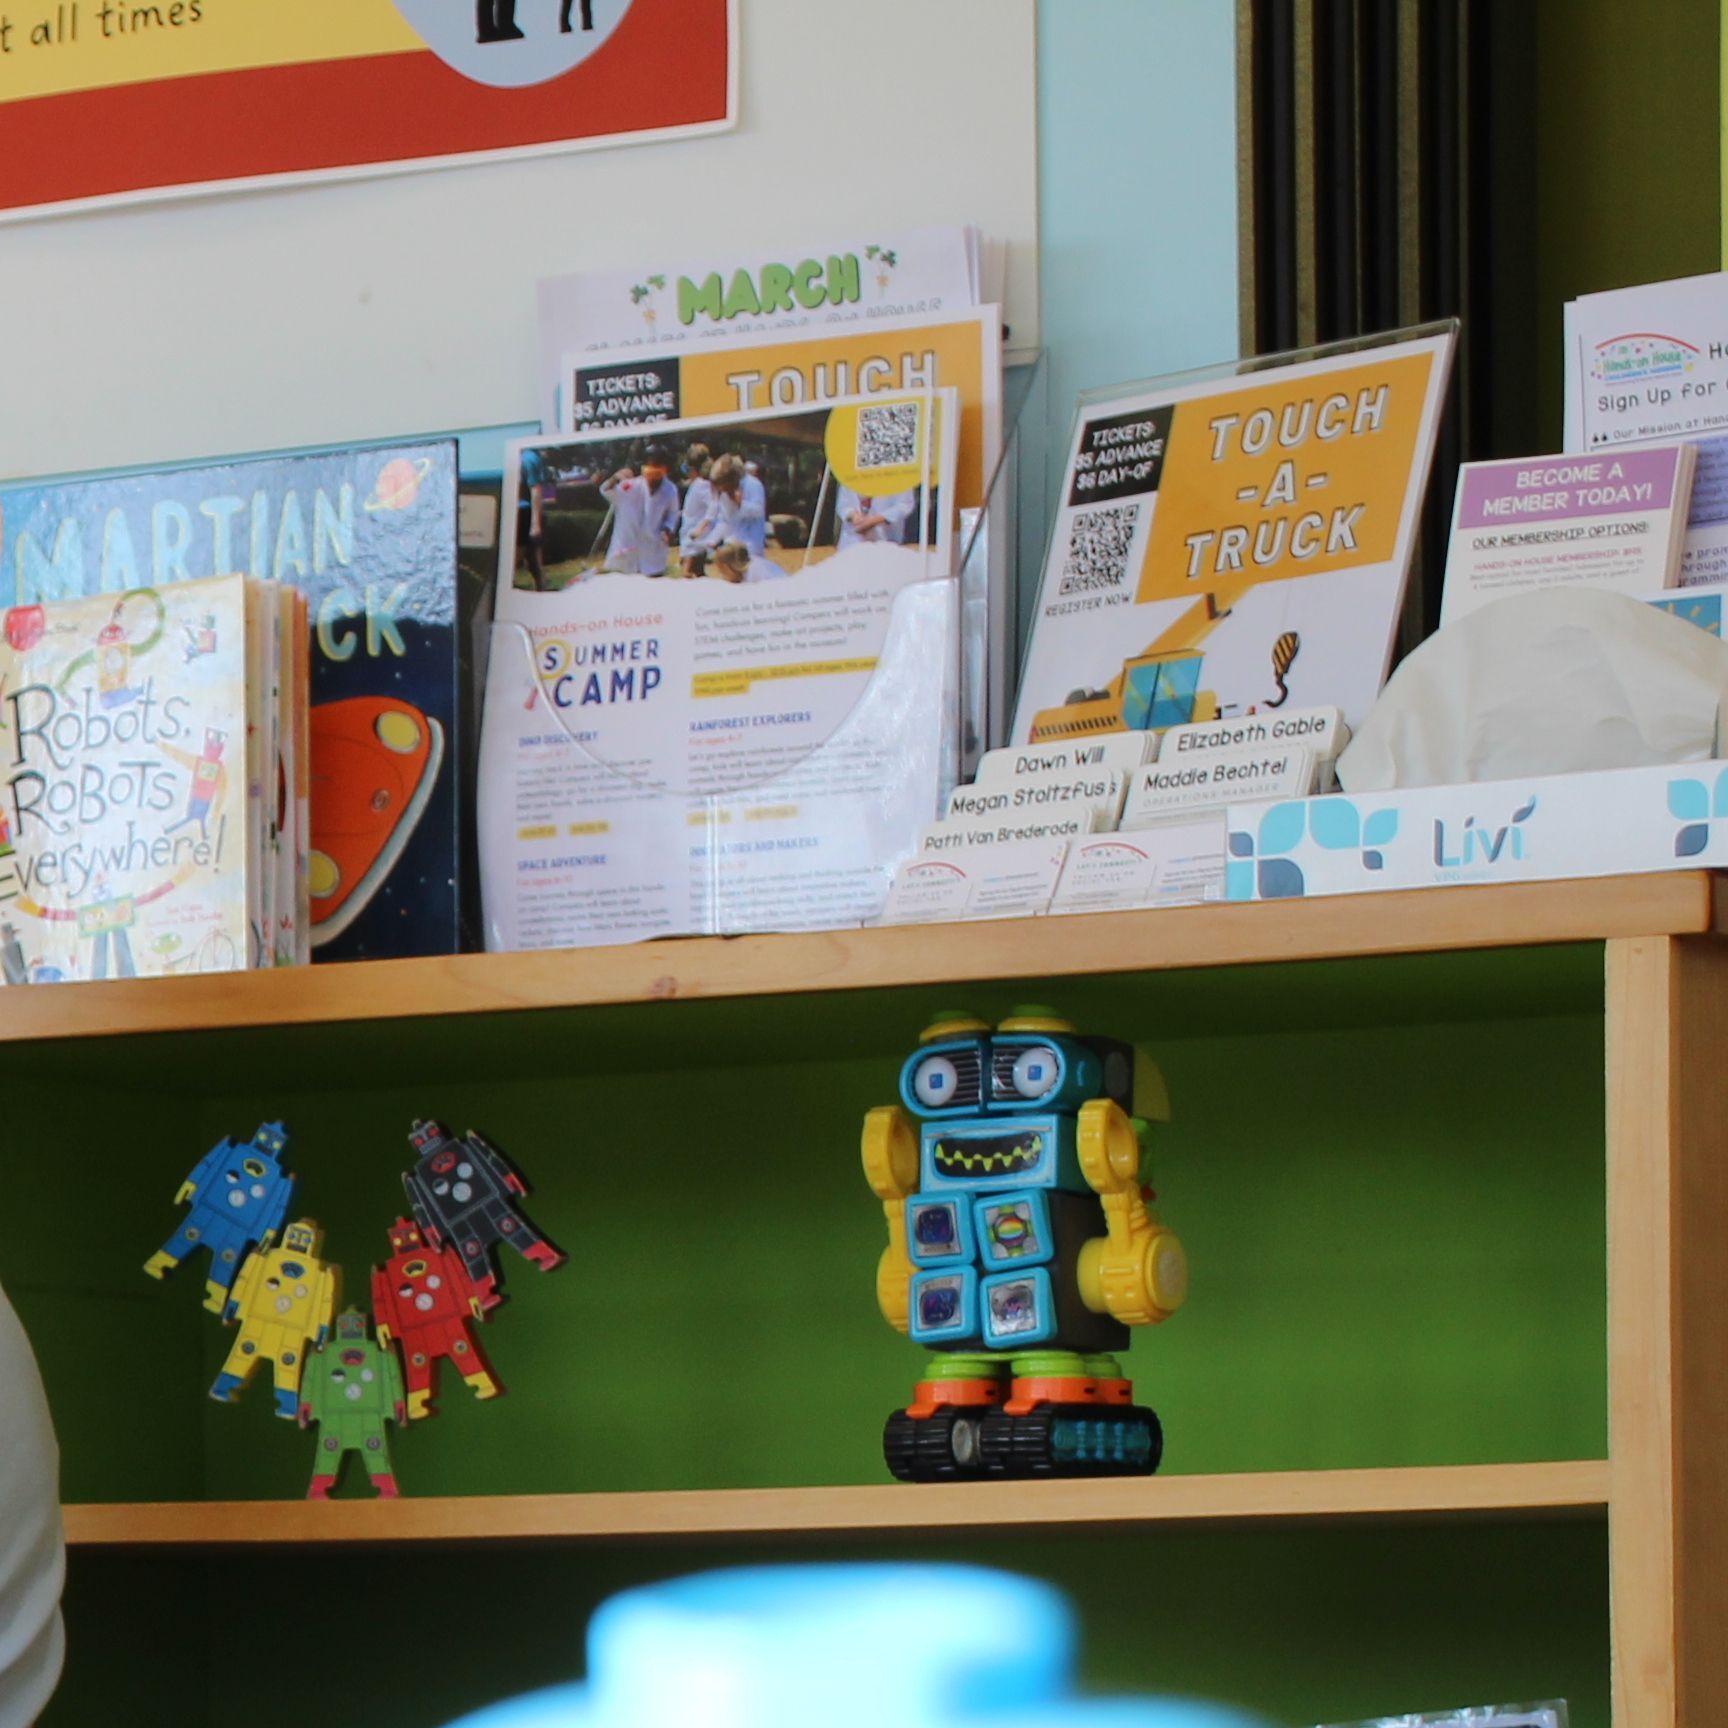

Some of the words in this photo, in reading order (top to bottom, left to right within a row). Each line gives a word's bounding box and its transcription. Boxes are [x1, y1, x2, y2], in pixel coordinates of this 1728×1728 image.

[30, 3, 78, 47] all
[95, 0, 203, 39] times
[677, 252, 860, 325] MARCH
[726, 350, 937, 413] TOUCH
[1597, 393, 1640, 413] Sign
[1646, 387, 1672, 406] Up
[1680, 381, 1718, 399] for
[597, 391, 675, 417] ADVANCE
[1207, 384, 1389, 464] TOUCH
[1096, 438, 1164, 468] ADVANCE
[1516, 463, 1603, 489] BECOME
[1606, 461, 1624, 482] A
[1482, 491, 1568, 518] MEMBER
[1575, 482, 1653, 508] TODAY!
[15, 483, 355, 605] MARTIAN
[1183, 503, 1366, 579] TRUCK
[1104, 591, 1132, 606] NOW
[613, 612, 664, 628] House
[544, 638, 660, 671] SUMMER
[553, 665, 661, 708] CAMP
[1178, 723, 1266, 752] Elizabeth
[1272, 715, 1327, 739] Gable
[1015, 751, 1067, 776] Dawn
[1073, 745, 1105, 768] Will
[1144, 767, 1208, 792] Maddie
[1212, 756, 1288, 783] Bechtel
[951, 789, 1010, 818] Megan
[925, 830, 963, 851] Patti
[967, 828, 994, 845] Van
[998, 821, 1079, 844] Brederode
[1432, 794, 1537, 868] Livi
